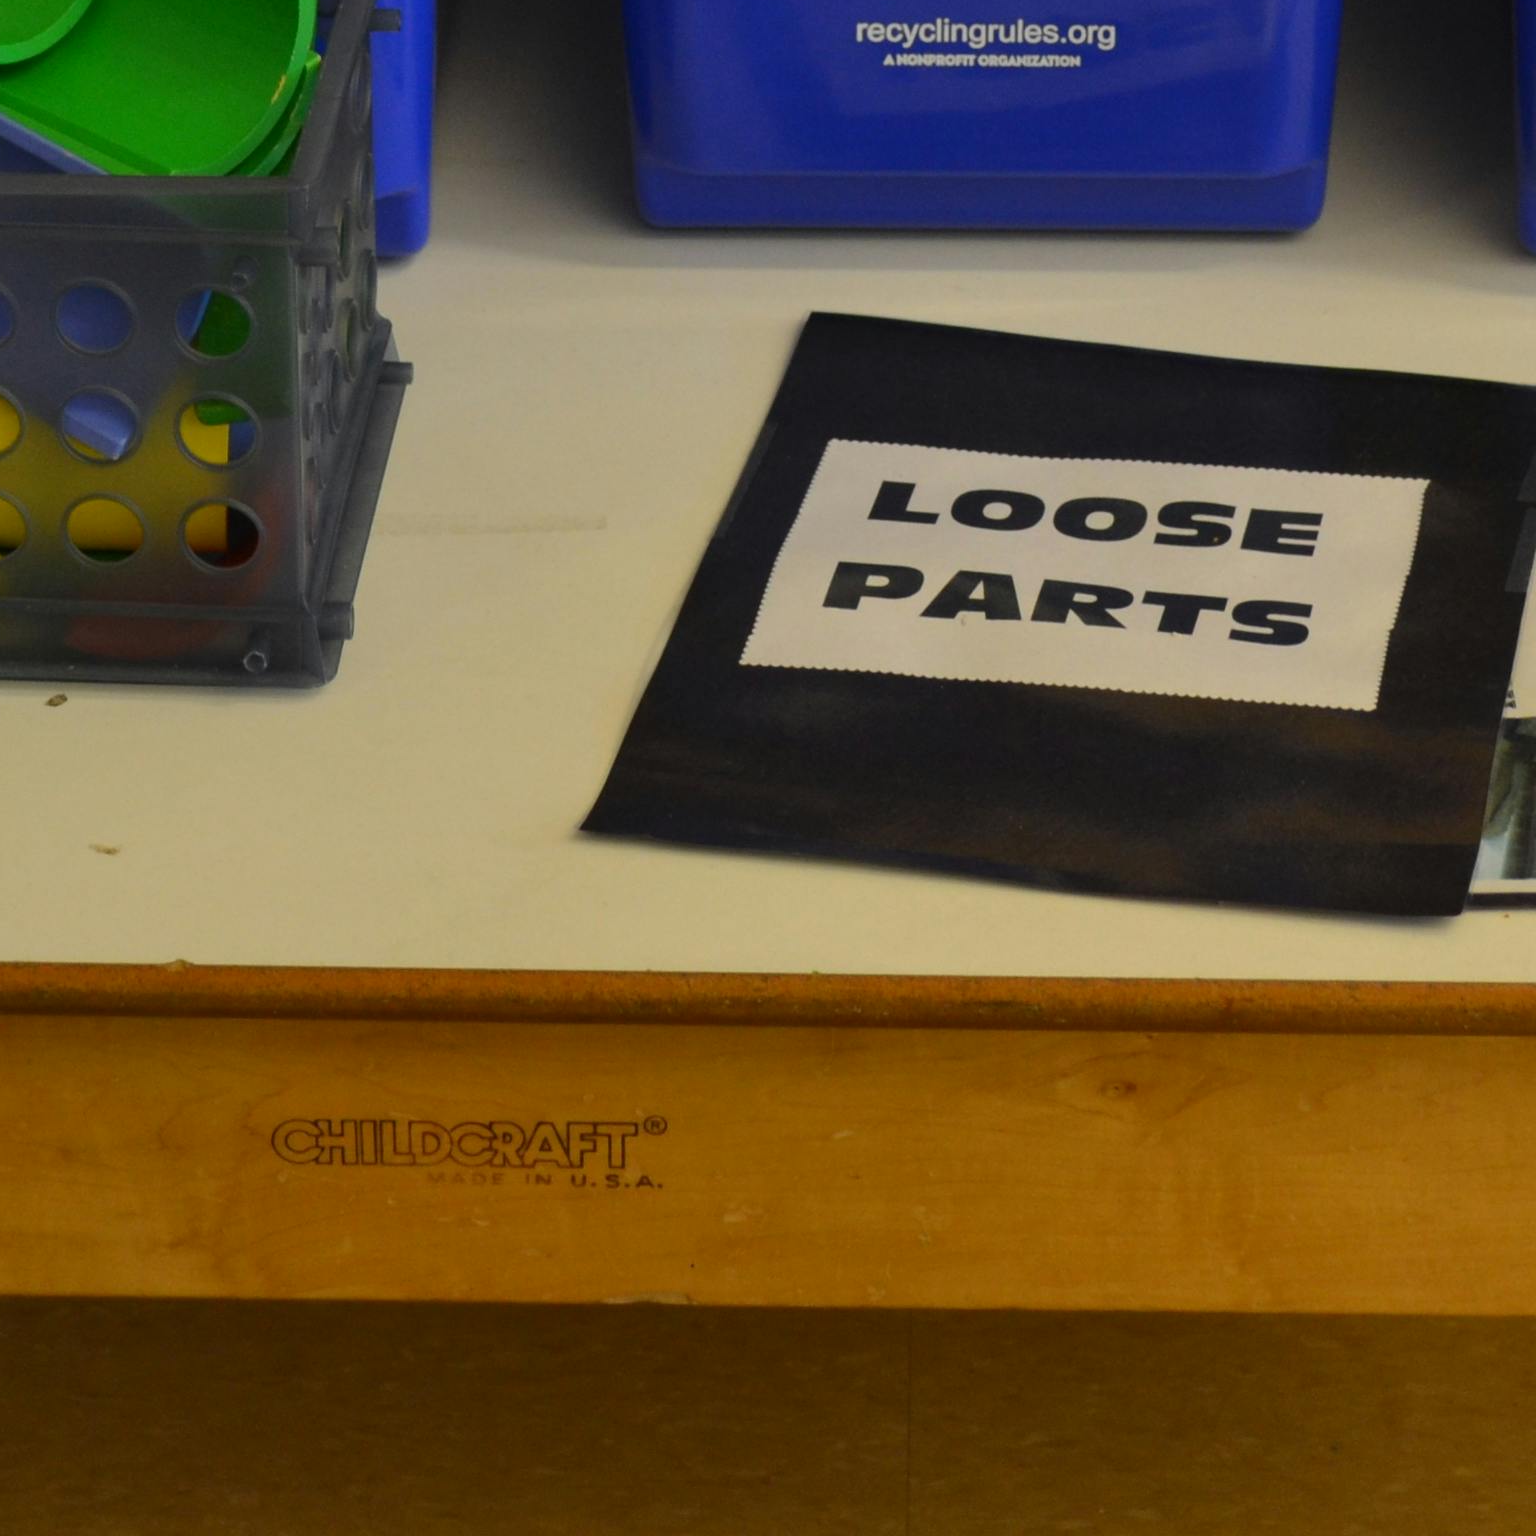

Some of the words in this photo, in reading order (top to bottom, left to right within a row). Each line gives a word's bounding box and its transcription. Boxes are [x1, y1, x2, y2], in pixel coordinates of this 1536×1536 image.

[855, 18, 1116, 50] recyclingrules.org
[883, 54, 895, 66] A
[896, 54, 977, 67] NONPROFIT
[978, 54, 1081, 68] ORGANIZATION
[867, 480, 1324, 556] LOOSE
[822, 561, 1313, 646] PARTS
[426, 1171, 504, 1187] MADE
[525, 1173, 552, 1186] IN
[570, 1173, 664, 1191] U.S.A.
